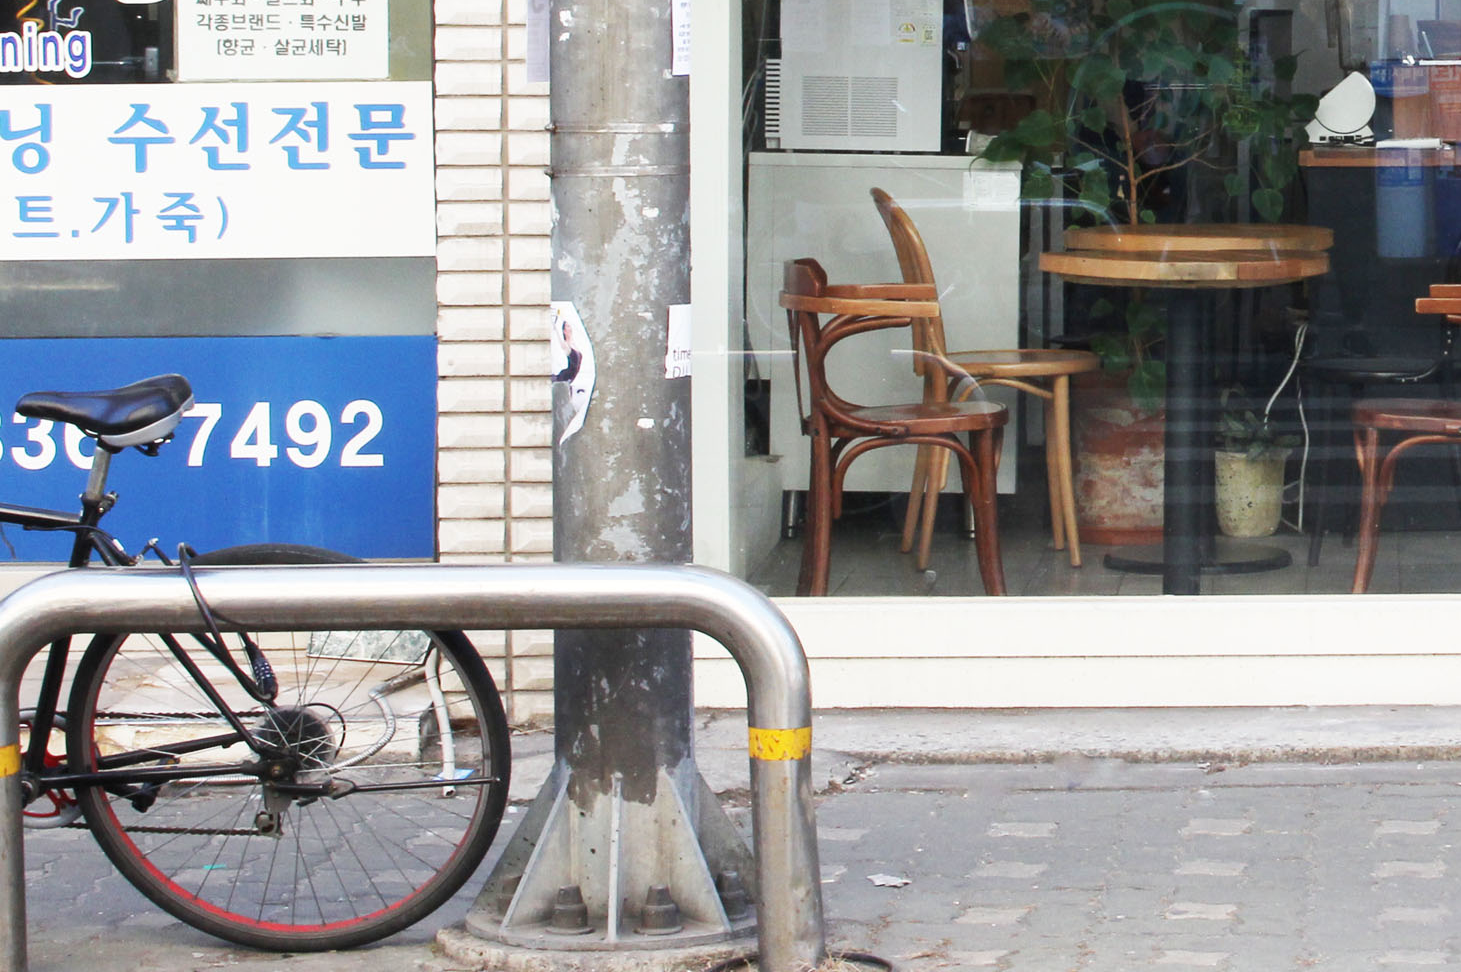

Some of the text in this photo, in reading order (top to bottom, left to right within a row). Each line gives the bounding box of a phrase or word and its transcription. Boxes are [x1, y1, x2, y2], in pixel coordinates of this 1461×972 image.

[196, 13, 367, 32] 각종브랜드 특수신발
[107, 101, 416, 174] 수선전문
